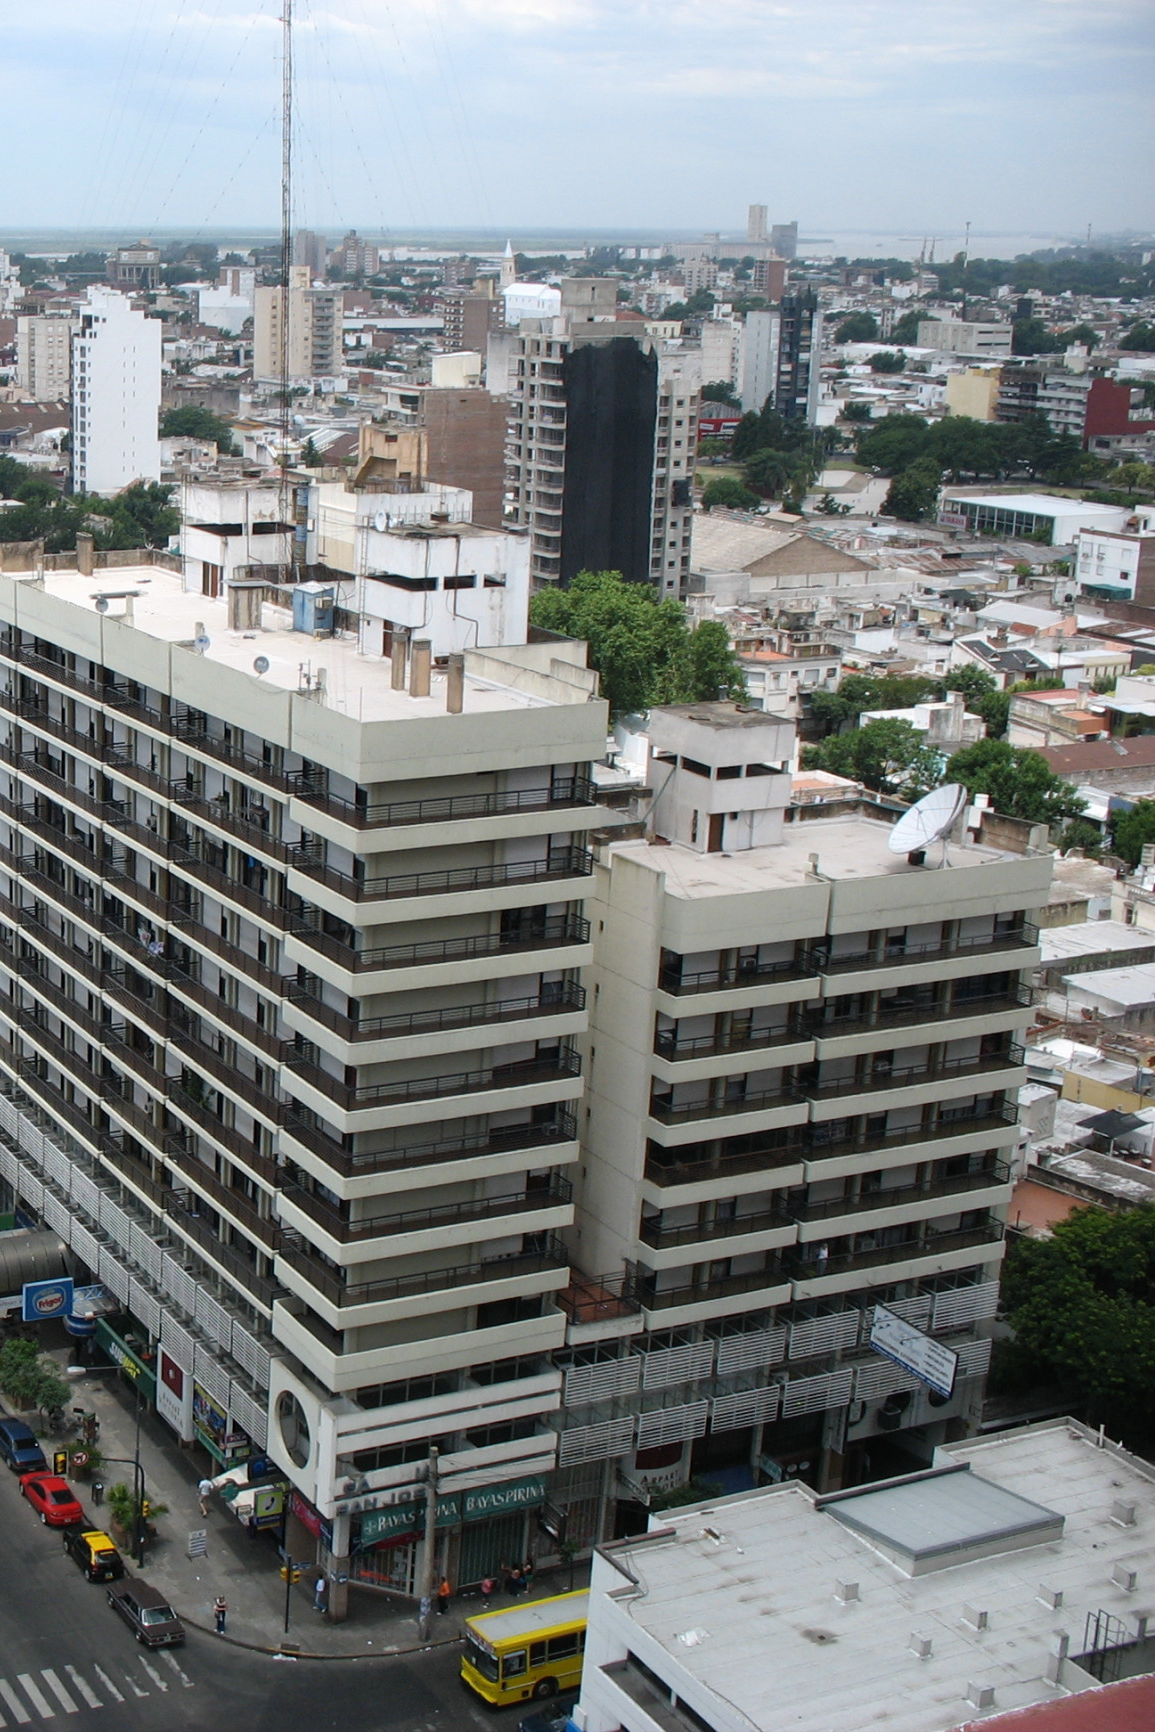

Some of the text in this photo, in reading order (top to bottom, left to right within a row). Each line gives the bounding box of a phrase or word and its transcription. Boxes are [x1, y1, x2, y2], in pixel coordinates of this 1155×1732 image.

[37, 1295, 63, 1310] Frigor
[383, 1488, 427, 1505] JOS
[466, 1483, 546, 1512] BAYASPIRINA
